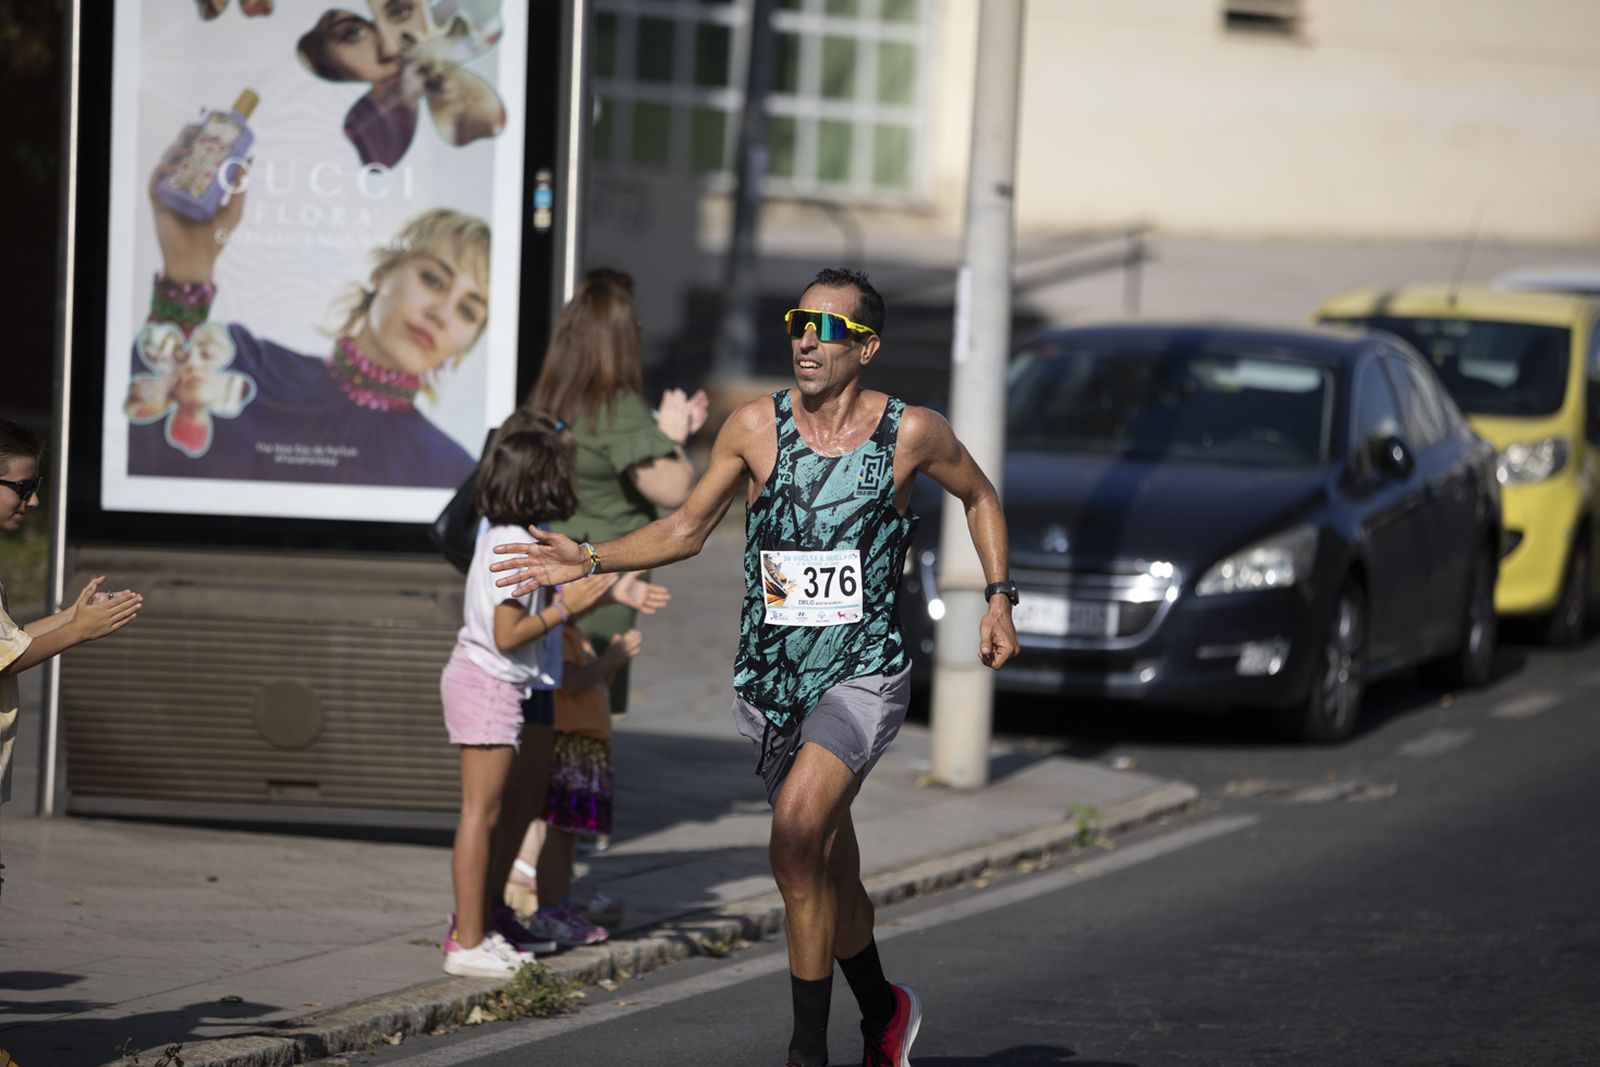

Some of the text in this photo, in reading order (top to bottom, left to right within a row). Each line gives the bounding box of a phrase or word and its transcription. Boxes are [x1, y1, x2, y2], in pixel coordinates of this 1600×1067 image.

[217, 157, 413, 201] GUCCI
[253, 202, 373, 226] FLORA
[803, 565, 857, 598] 376
